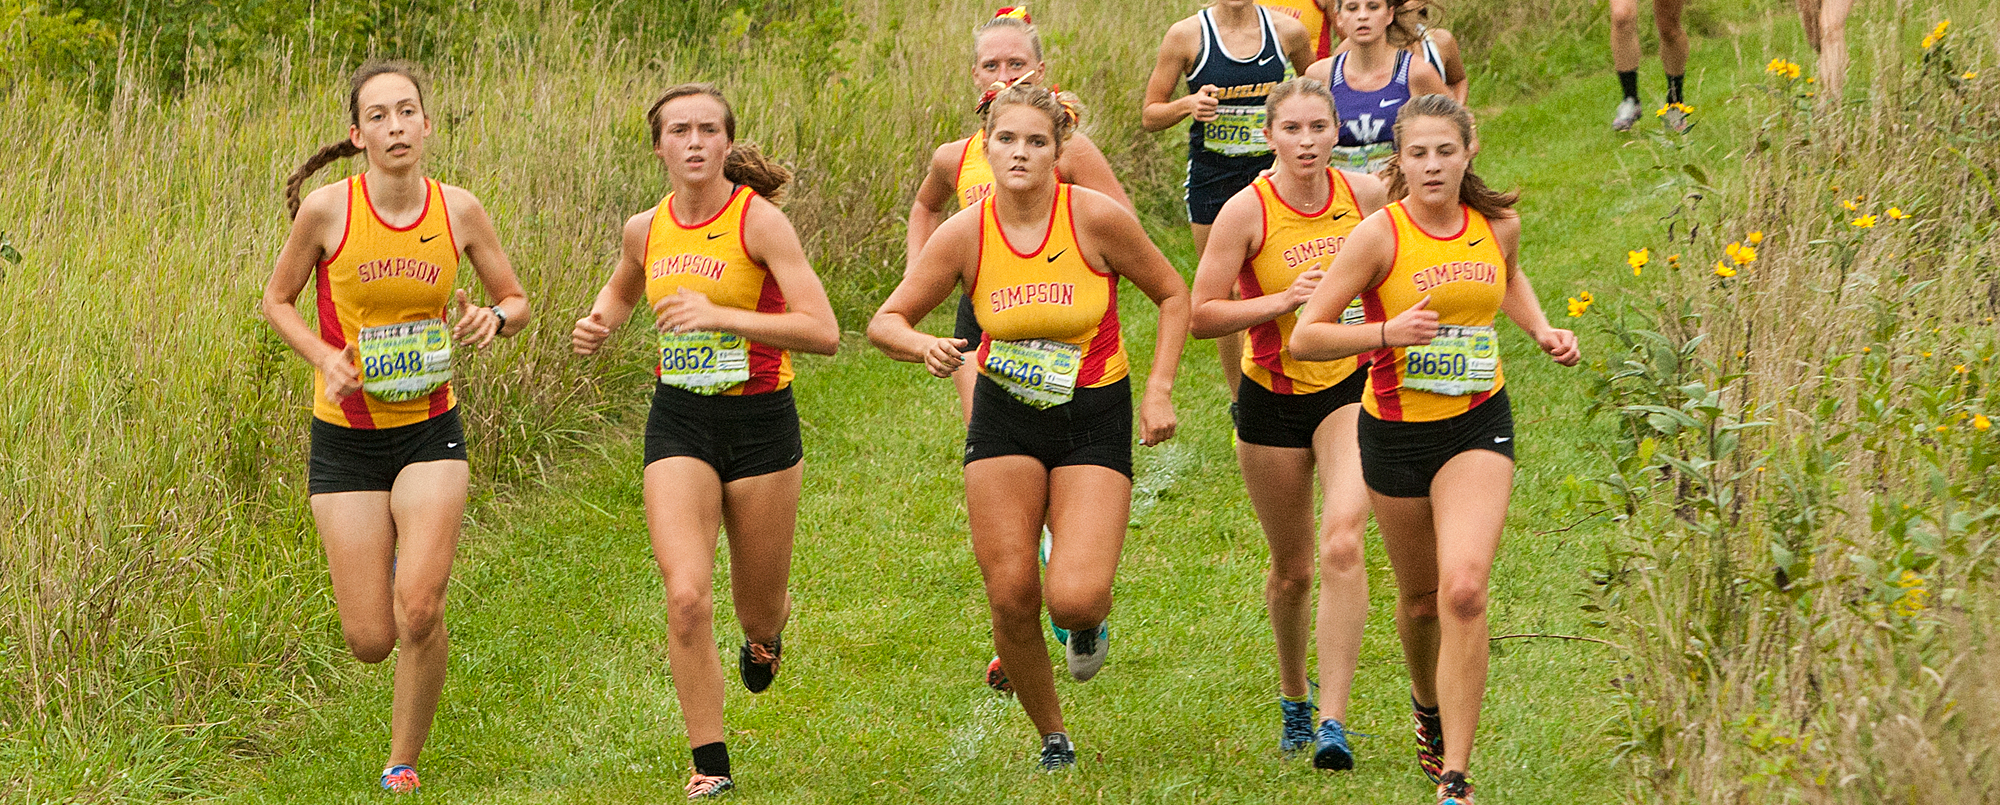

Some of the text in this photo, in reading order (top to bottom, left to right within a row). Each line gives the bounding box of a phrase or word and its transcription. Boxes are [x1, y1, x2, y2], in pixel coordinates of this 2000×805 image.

[1211, 81, 1277, 100] RACELAN
[1206, 123, 1250, 141] 8676
[964, 182, 992, 206] SIM
[1282, 235, 1346, 269] SIMPSO
[357, 257, 442, 287] SIMPSON
[651, 253, 728, 282] SIMPSON
[1412, 261, 1498, 293] SIMPSON
[989, 281, 1075, 314] SIMPSON
[364, 350, 423, 379] 8648
[663, 346, 714, 371] 8652
[987, 356, 1043, 386] 8646
[1406, 352, 1466, 377] 8650
